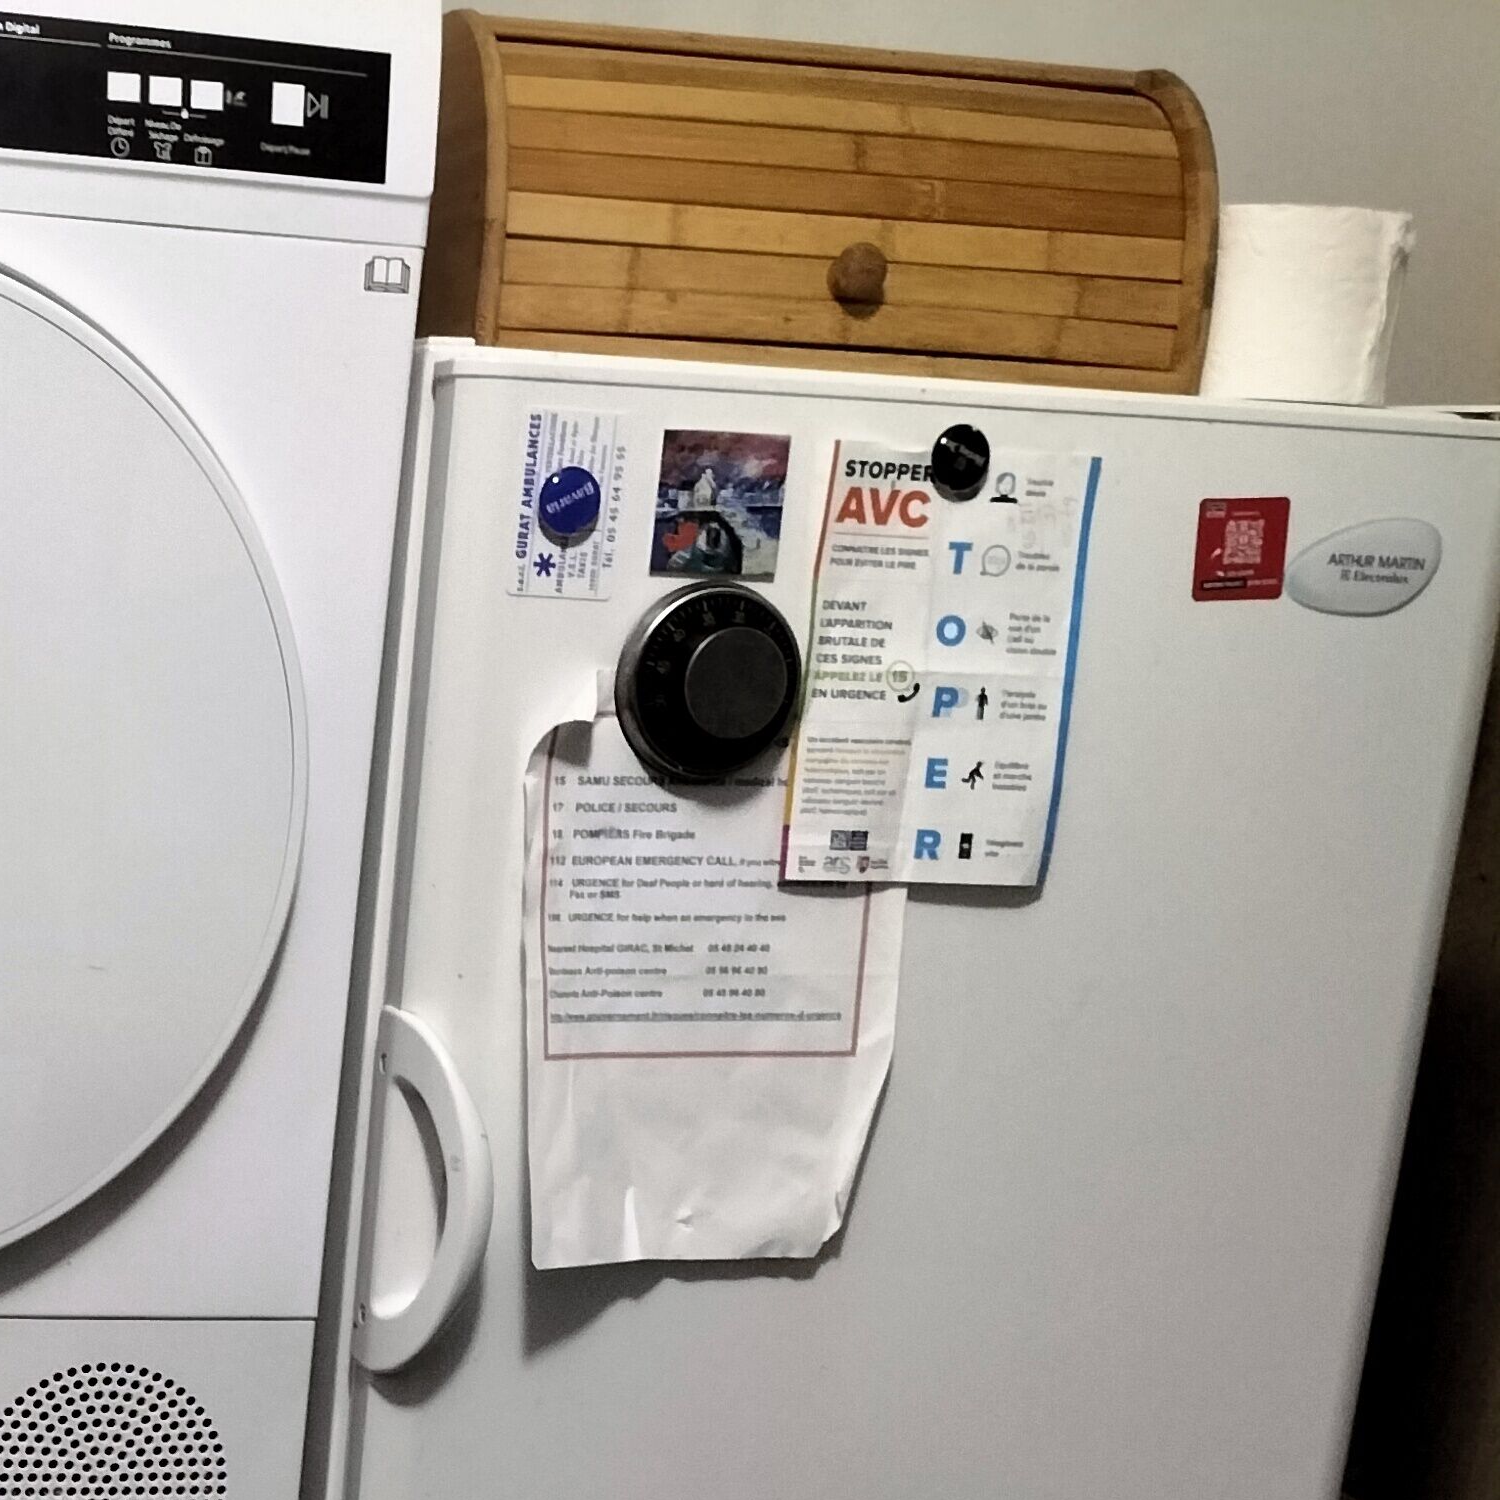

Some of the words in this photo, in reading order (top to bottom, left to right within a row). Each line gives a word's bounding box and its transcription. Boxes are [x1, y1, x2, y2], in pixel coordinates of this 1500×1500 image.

[5, 21, 41, 35] Digital
[521, 413, 542, 509] AMBULANCES
[835, 486, 931, 528] AVC
[515, 514, 531, 559] GURAT
[948, 541, 974, 575] T
[1327, 553, 1375, 568] ARTHUR
[1378, 555, 1425, 571] MARTIN
[822, 600, 867, 611] DEVANT
[819, 618, 893, 631] L'APPARITION
[936, 614, 966, 647] O
[818, 635, 867, 647] BRUTALE
[870, 637, 886, 648] DE
[816, 653, 838, 664] CES
[841, 654, 882, 665] SIGNES
[869, 672, 883, 683] LE
[891, 670, 908, 683] 15
[811, 688, 828, 699] EN
[831, 689, 886, 700] URGENCE
[932, 686, 959, 717] P
[925, 757, 949, 789] E
[578, 776, 611, 786] SAMU
[575, 802, 616, 813] POLICE
[624, 802, 677, 813] SECOURS
[655, 829, 695, 842] Brigade
[914, 828, 941, 860] R
[572, 856, 632, 866] EUROPEAN
[635, 856, 703, 866] EMERGENCY
